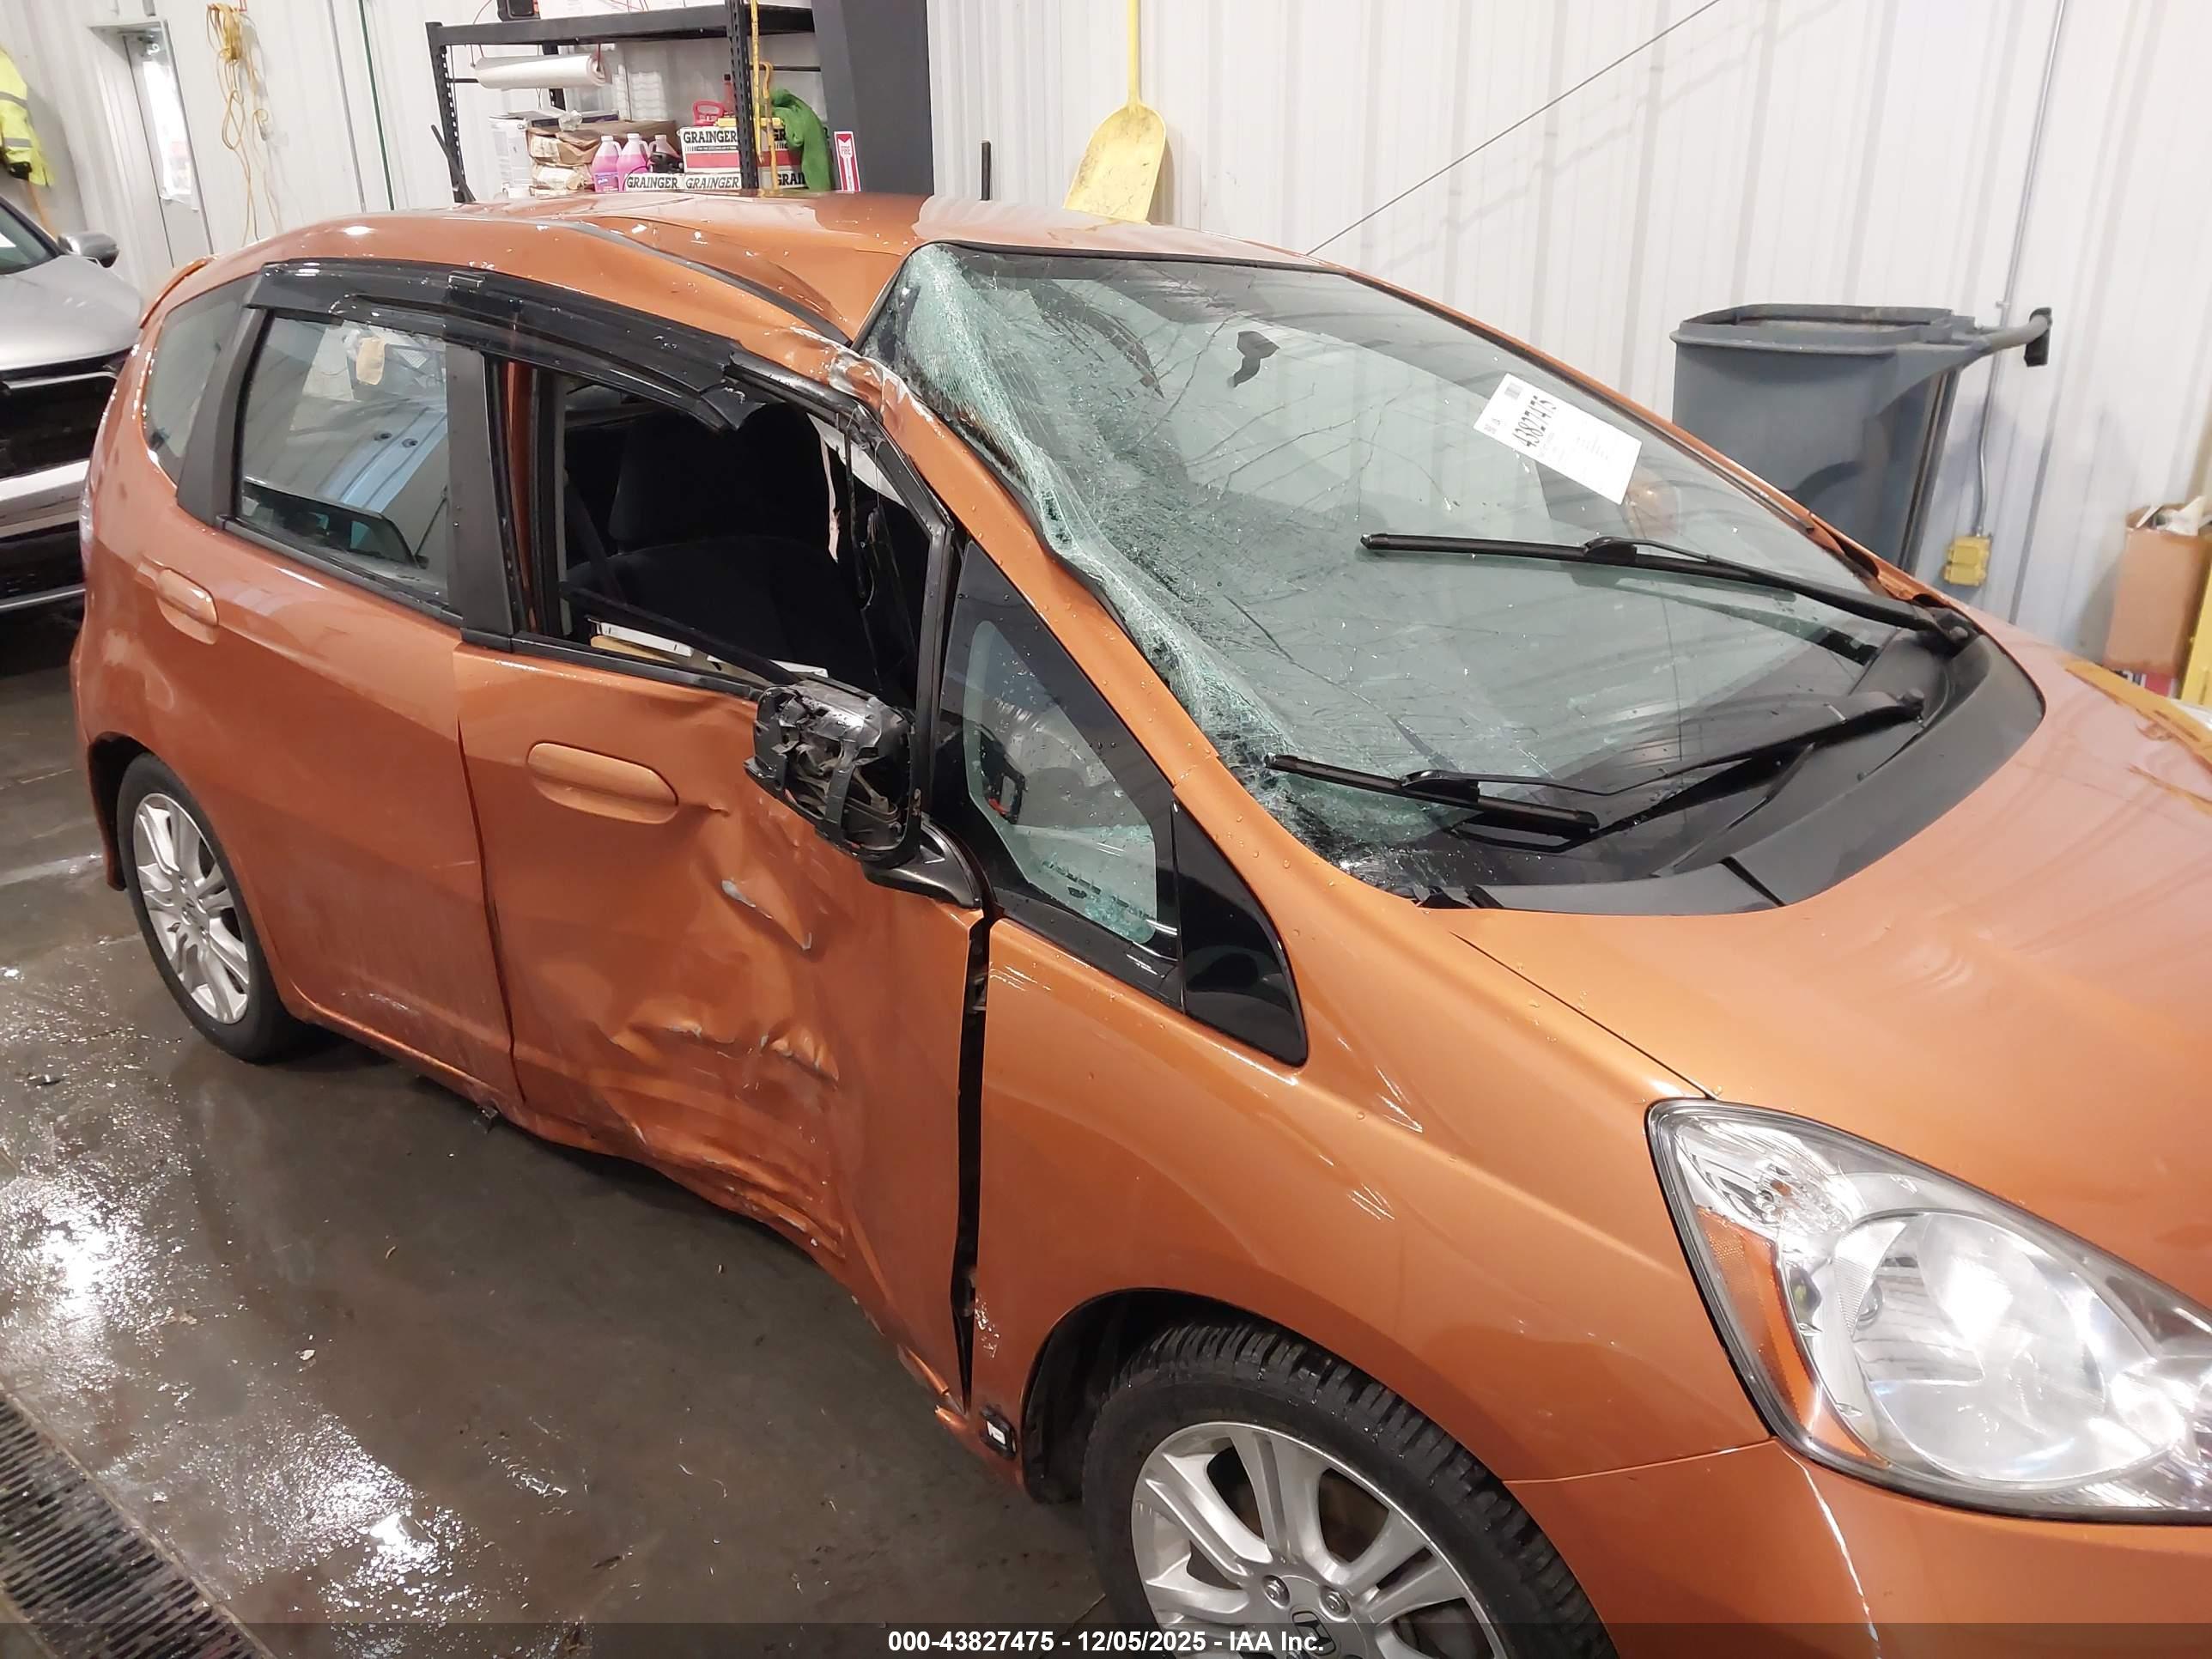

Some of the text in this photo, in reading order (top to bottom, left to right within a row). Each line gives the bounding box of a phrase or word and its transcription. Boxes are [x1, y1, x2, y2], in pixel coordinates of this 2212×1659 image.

[684, 131, 738, 143] GRAINGER
[627, 176, 678, 188] GRAINGER
[685, 177, 739, 188] GRAINGER
[1512, 395, 1557, 447] 43827475
